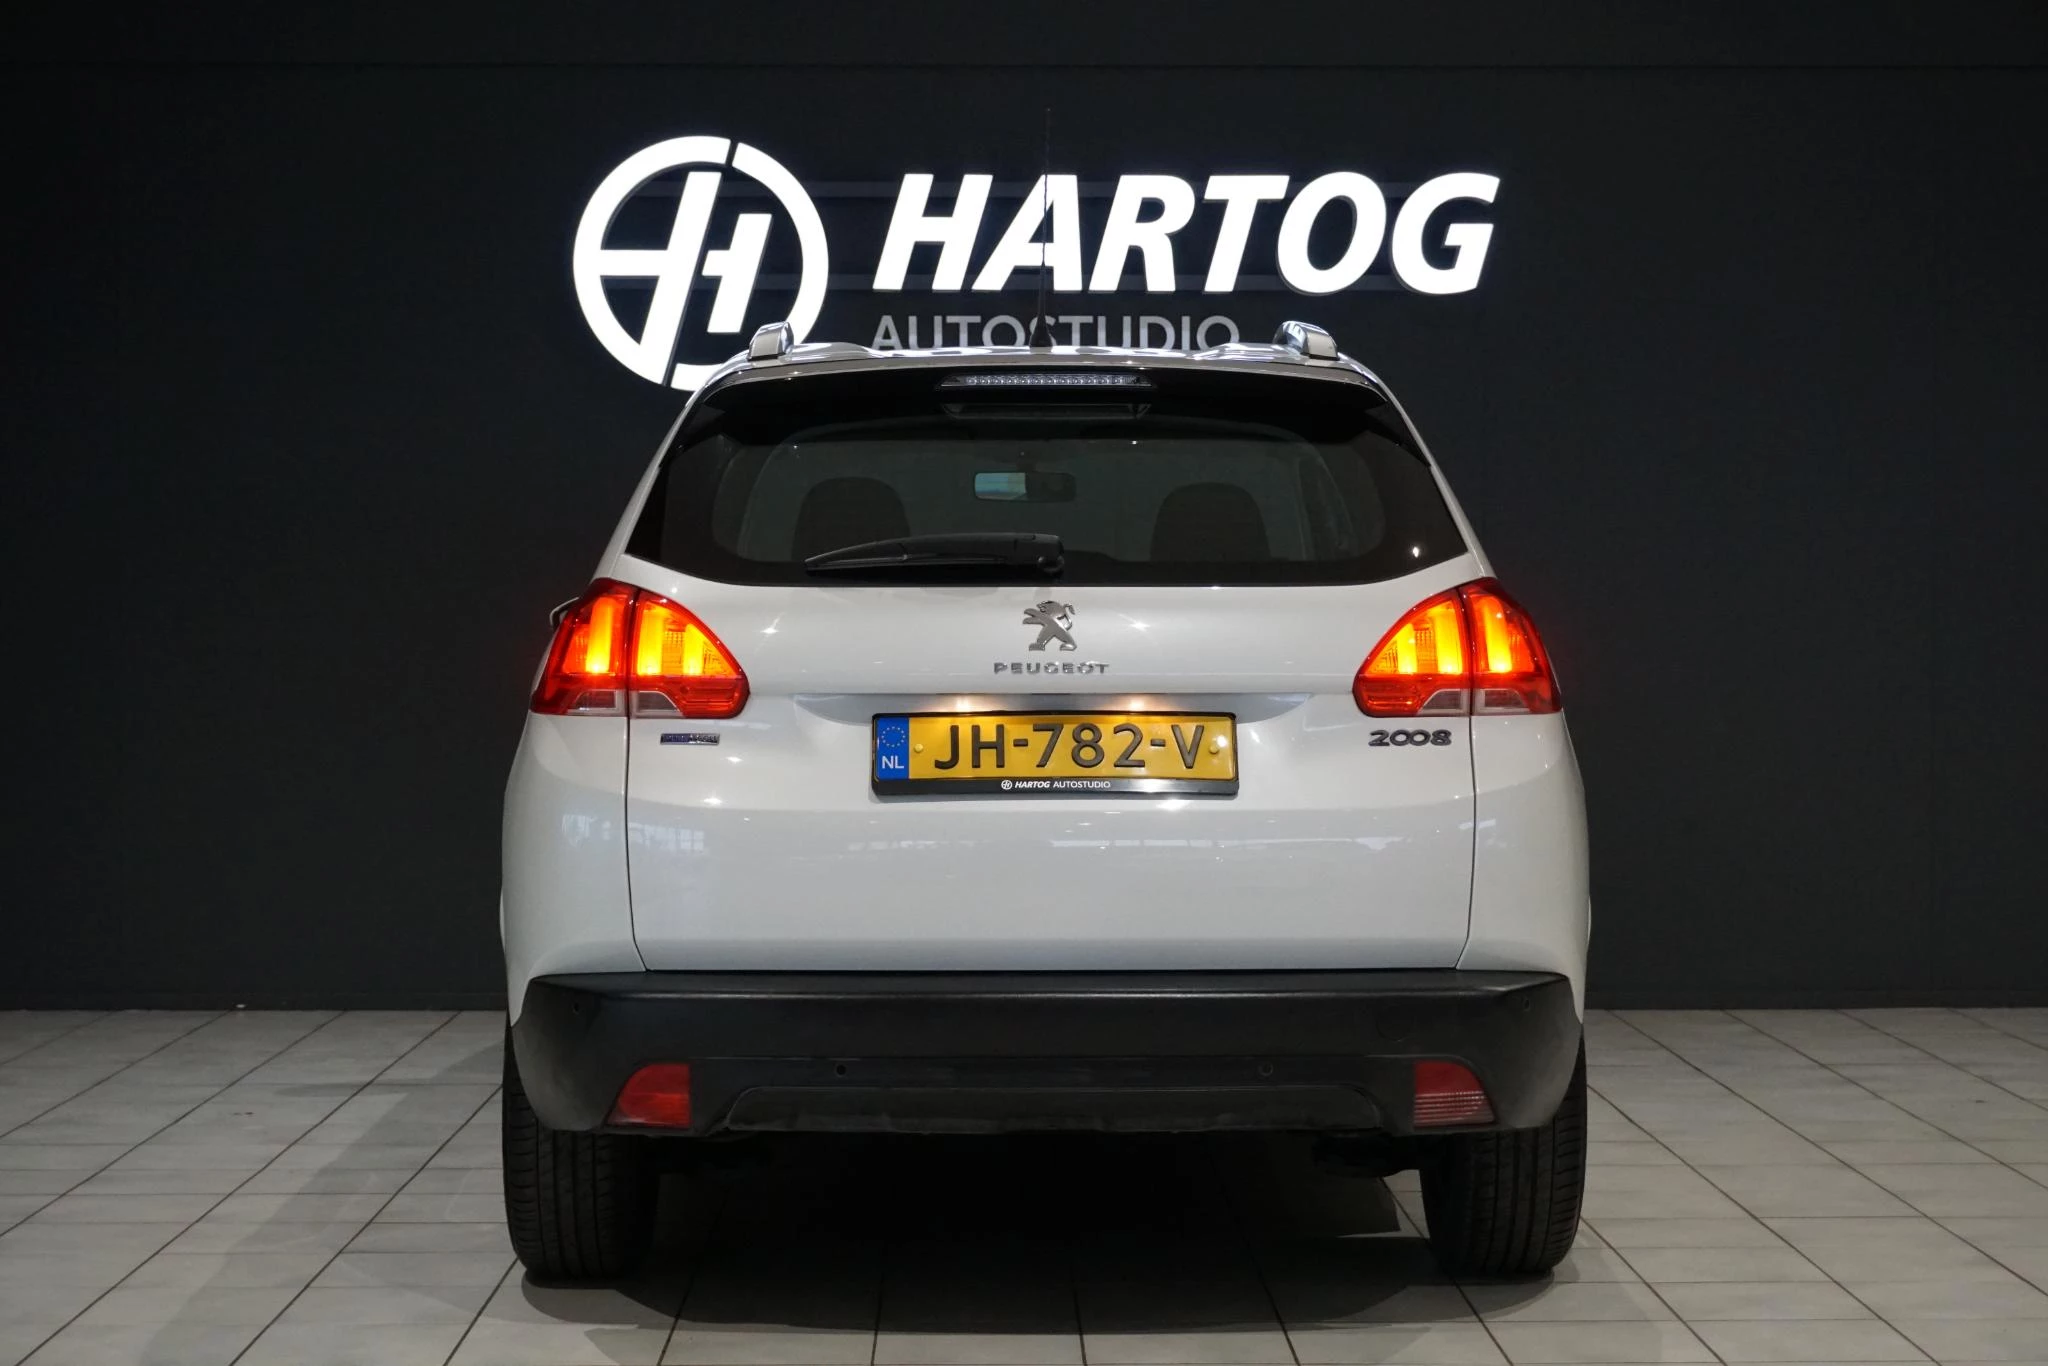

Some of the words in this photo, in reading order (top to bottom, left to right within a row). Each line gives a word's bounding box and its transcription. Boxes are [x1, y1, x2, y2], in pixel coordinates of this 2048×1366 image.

[873, 171, 1500, 294] HARTOG
[994, 662, 1109, 674] PEUGEOT
[934, 723, 1204, 769] JH-782-V
[1368, 729, 1452, 746] 2008
[881, 756, 905, 769] NL
